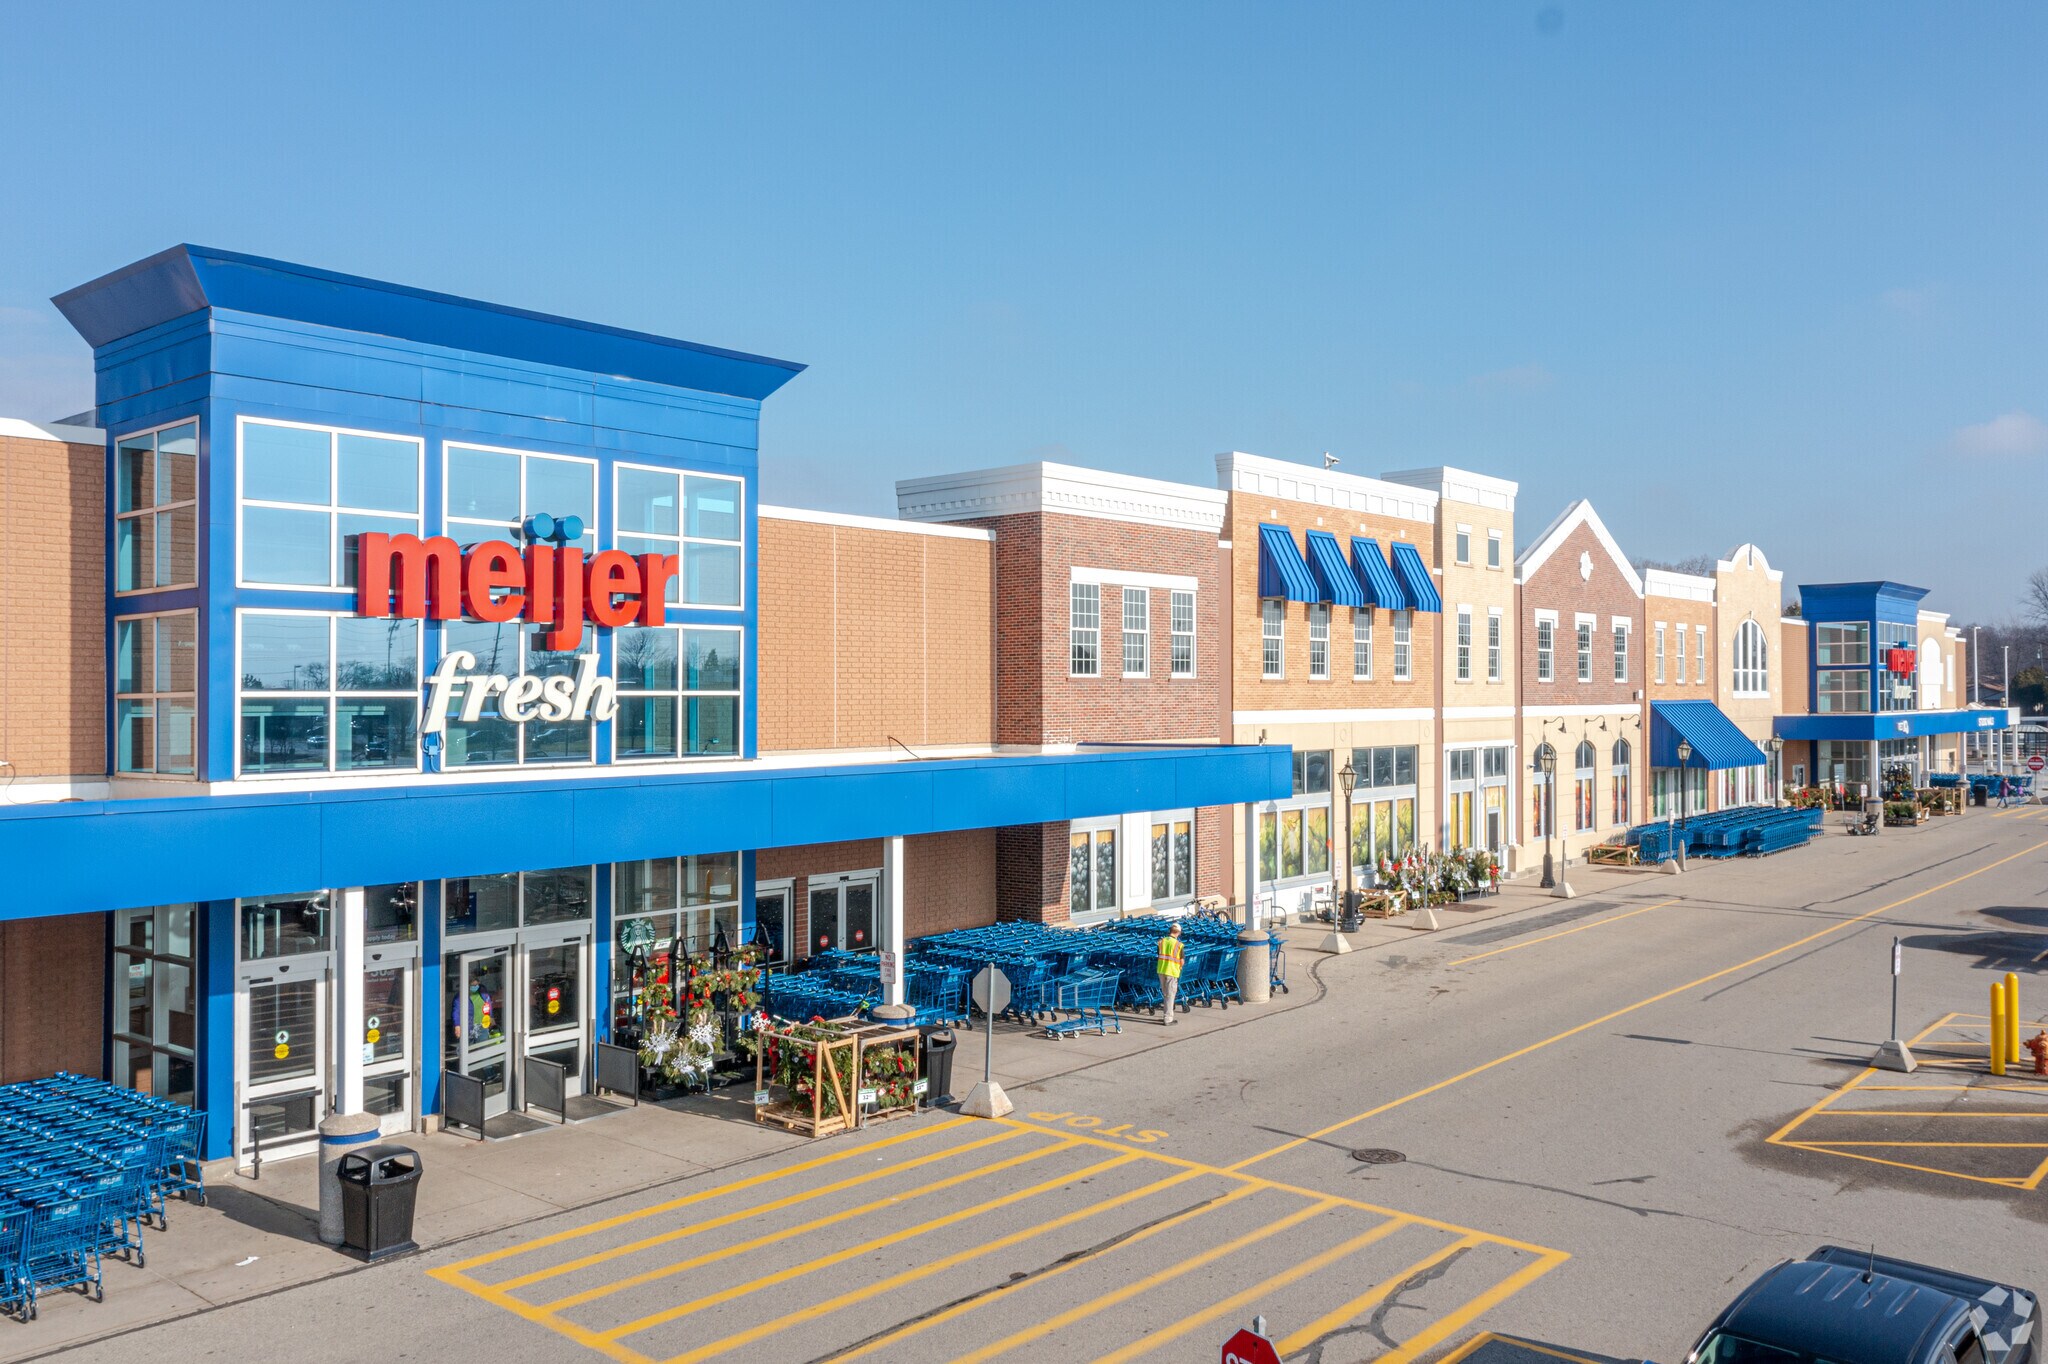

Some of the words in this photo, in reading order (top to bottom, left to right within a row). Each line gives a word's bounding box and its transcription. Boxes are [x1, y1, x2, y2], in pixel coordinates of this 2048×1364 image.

[357, 513, 679, 651] meijer
[420, 650, 620, 734] fresh
[1027, 1111, 1169, 1143] STOP
